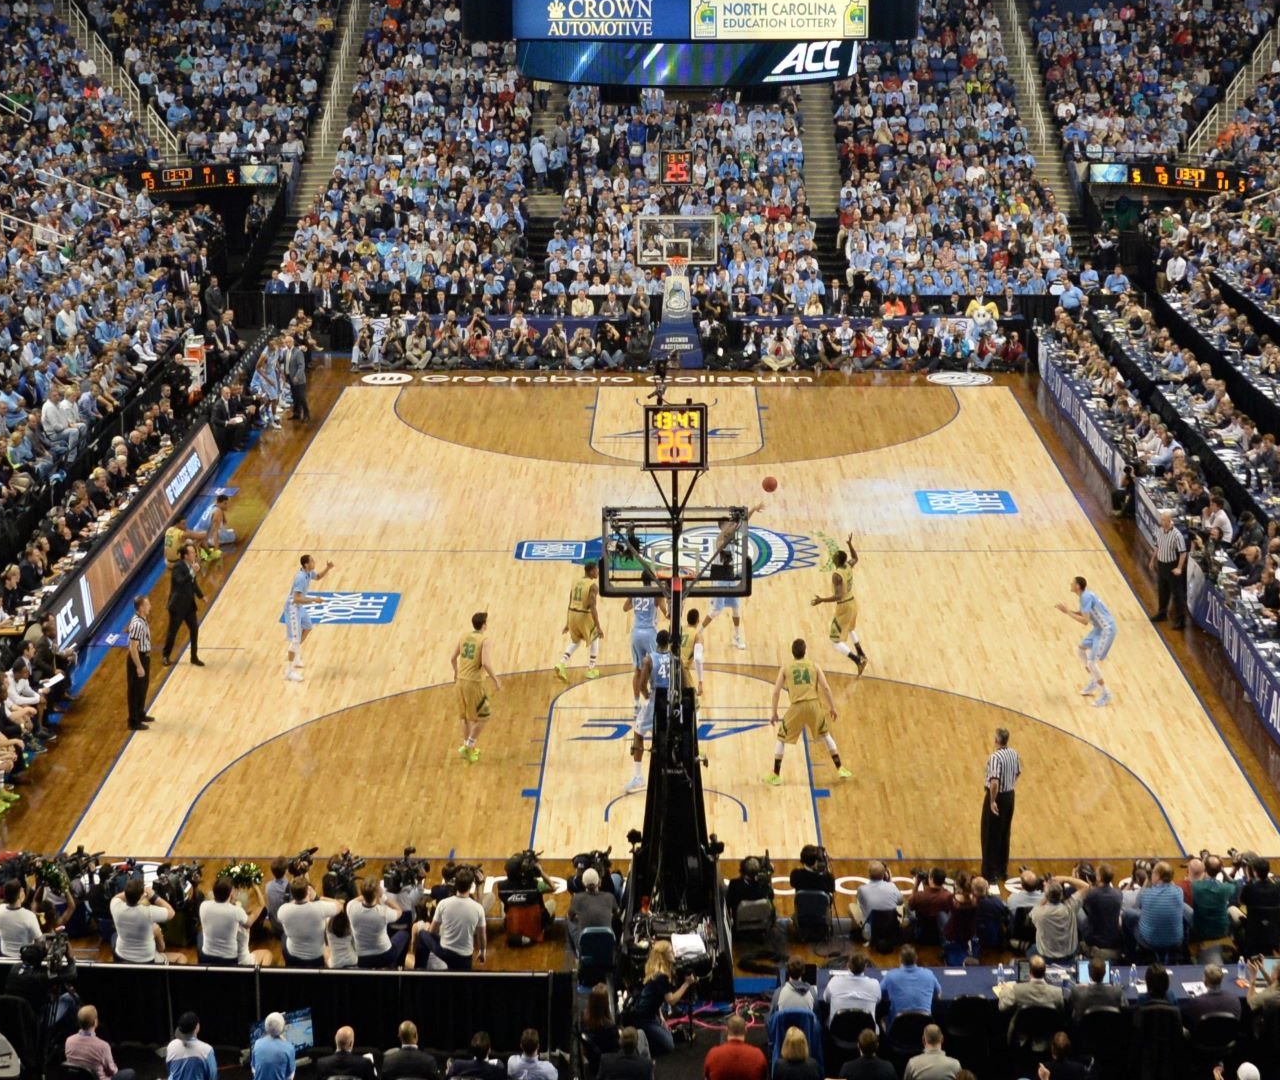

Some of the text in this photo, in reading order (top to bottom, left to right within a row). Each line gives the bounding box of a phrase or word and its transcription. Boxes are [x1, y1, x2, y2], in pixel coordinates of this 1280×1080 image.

[722, 2, 838, 17] NORTH CAROLINA
[547, 21, 654, 37] AUTOMOTIVE
[722, 18, 838, 29] EDUCATION LOTTERY
[771, 40, 843, 74] ACC
[421, 374, 814, 384] Greensboro Coliseum
[654, 411, 699, 429] 13:47
[320, 593, 362, 623] YORK
[358, 593, 388, 621] LIFE
[633, 599, 650, 612] 22
[55, 598, 79, 646] ACC
[461, 642, 476, 660] 32
[792, 668, 811, 686] 24
